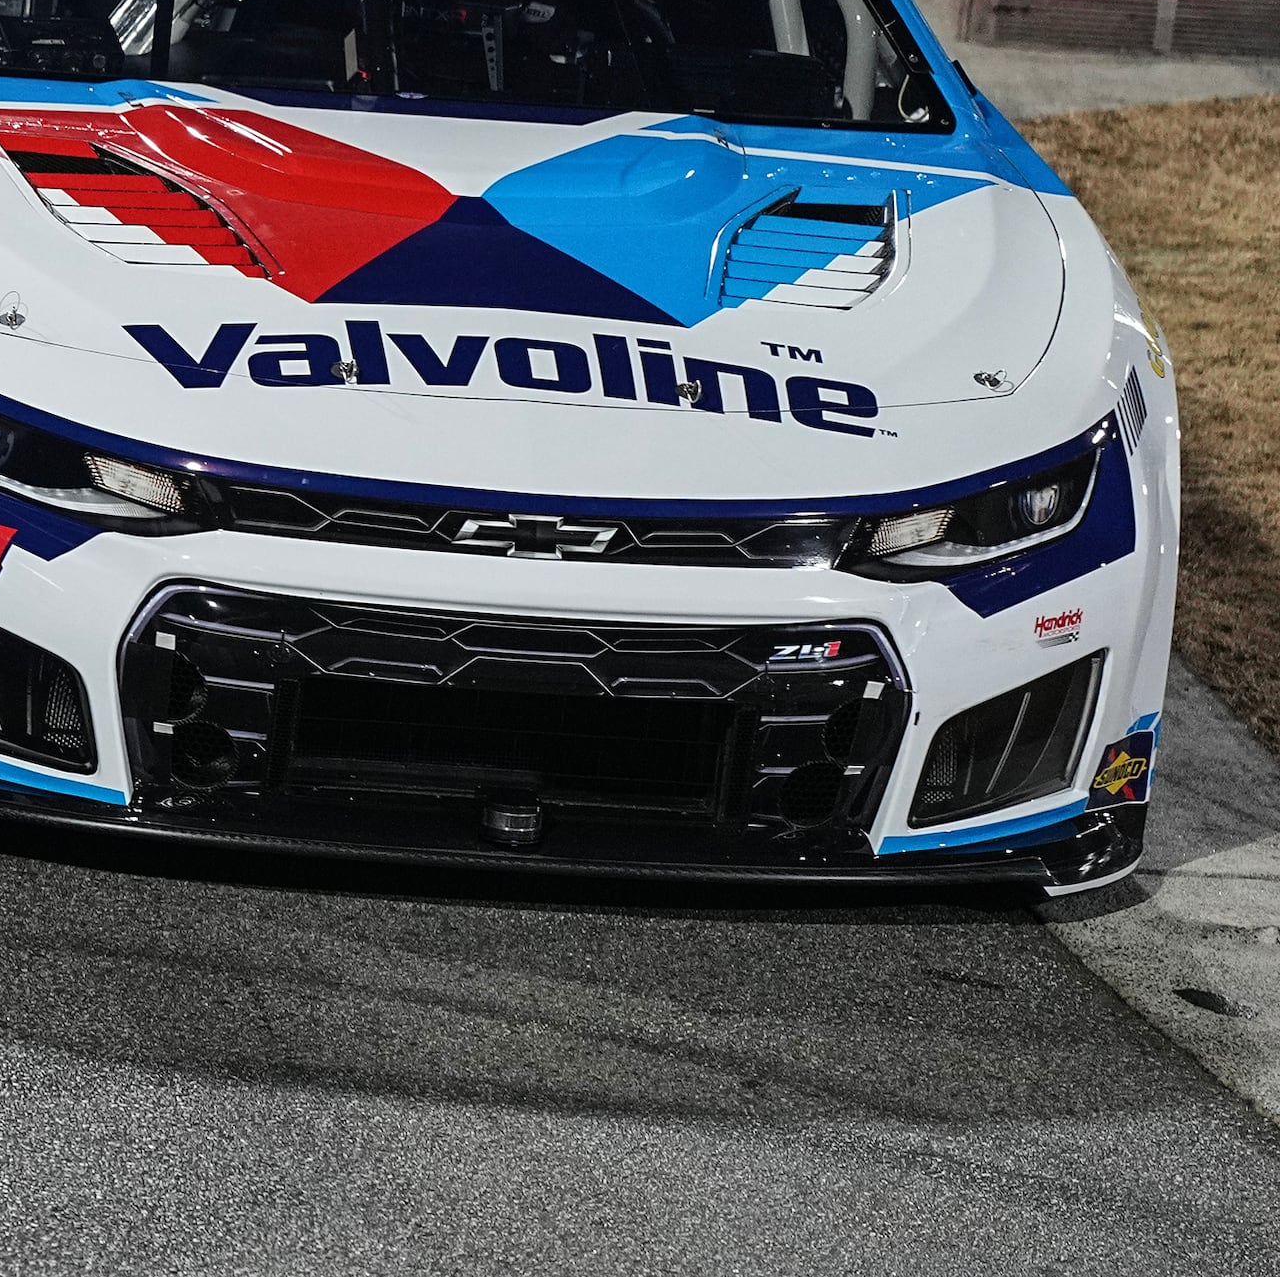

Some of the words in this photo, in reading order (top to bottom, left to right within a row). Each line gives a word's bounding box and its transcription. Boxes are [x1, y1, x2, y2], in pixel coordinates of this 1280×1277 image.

[122, 319, 880, 439] Valvoline
[760, 340, 824, 364] TM
[1033, 608, 1083, 638] Hendrick
[769, 641, 841, 661] ZL1
